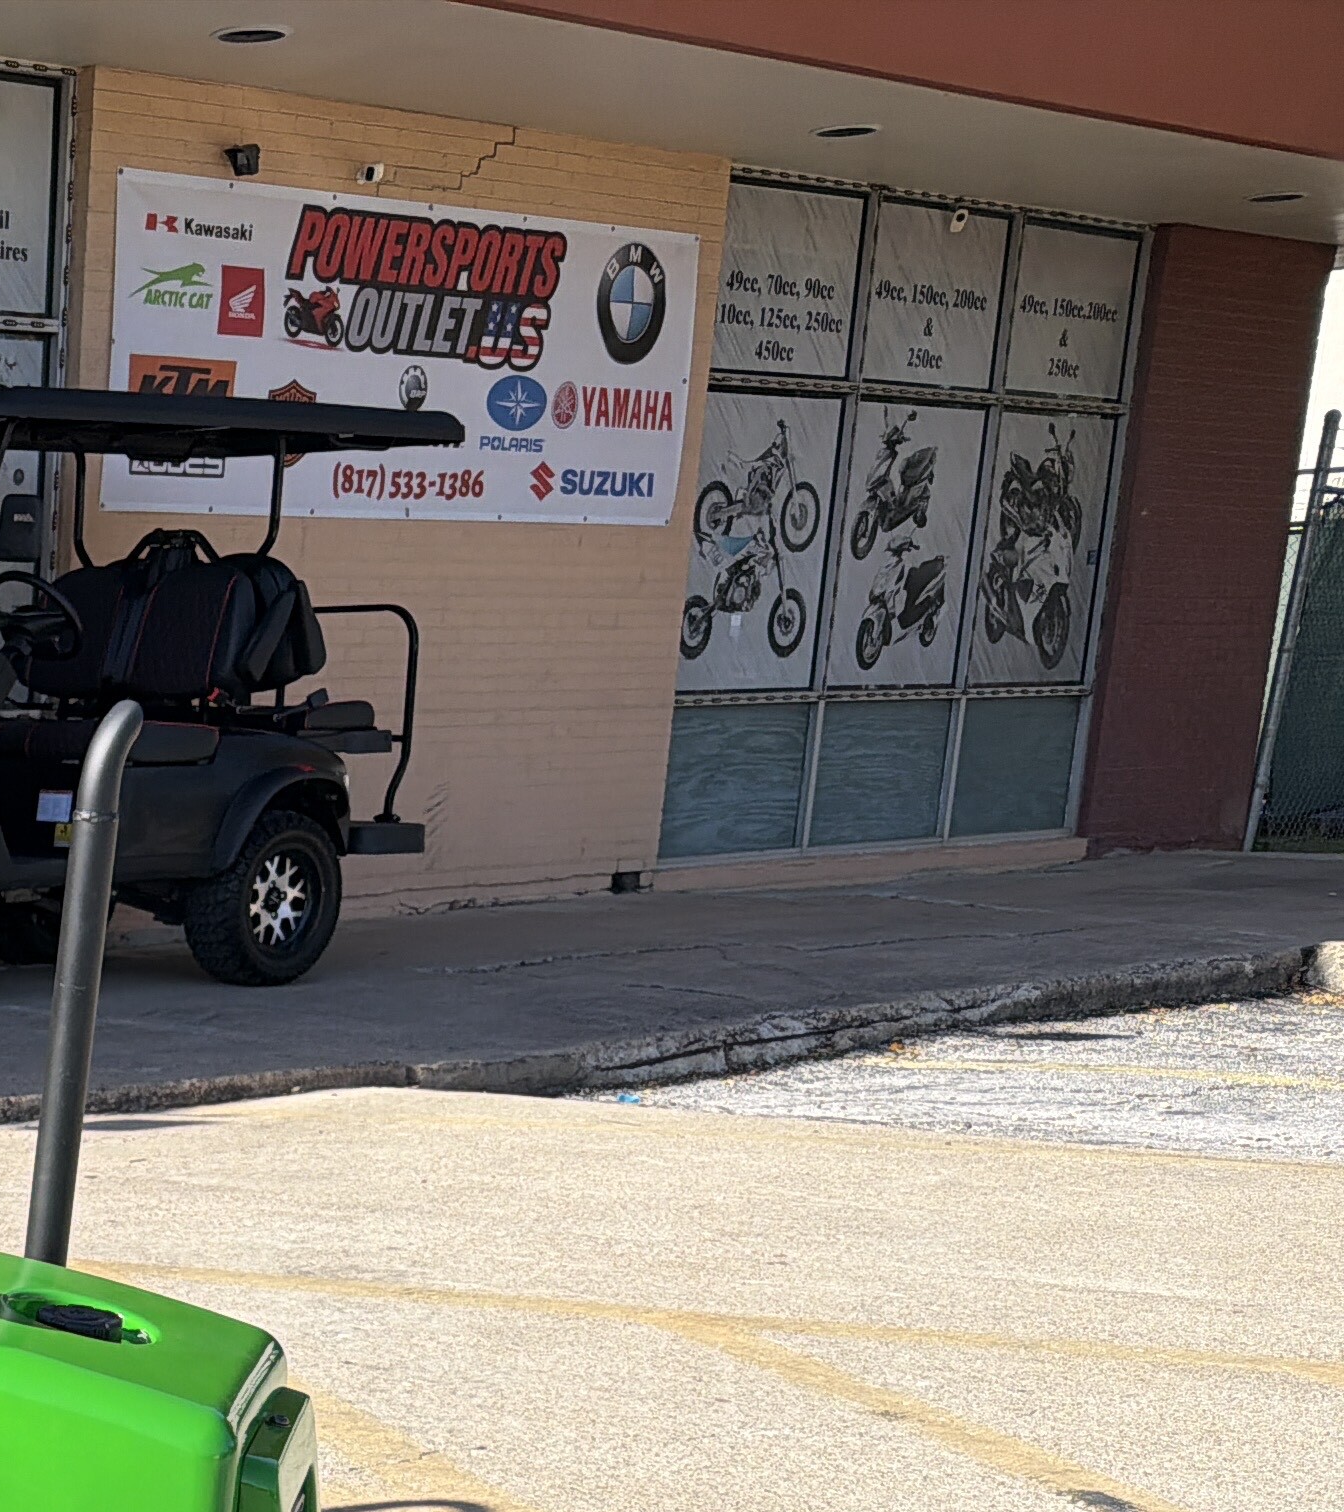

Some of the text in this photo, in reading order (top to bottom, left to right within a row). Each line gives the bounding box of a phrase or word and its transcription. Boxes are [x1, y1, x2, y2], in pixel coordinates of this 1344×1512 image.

[184, 217, 253, 241] Kawasaki
[287, 206, 566, 300] POWERSPORTS
[606, 245, 664, 283] BMW
[143, 288, 213, 310] ARCTIC CAT
[726, 270, 834, 300] 49cc, 70cc, 90cc
[875, 279, 987, 311] 49cc, 150cc, 200cc
[346, 287, 550, 370] OUTLET.US
[759, 307, 800, 334] 125cc,
[805, 311, 842, 333] 250cc
[923, 317, 933, 337] &
[755, 340, 794, 362] 450cc
[907, 347, 943, 369] 250cc
[1048, 357, 1079, 379] 250cc
[582, 386, 672, 431] YAMAHA
[479, 435, 545, 453] POLARIS
[333, 461, 484, 500] (817) 533-1386
[560, 468, 655, 498] SUZUKI
